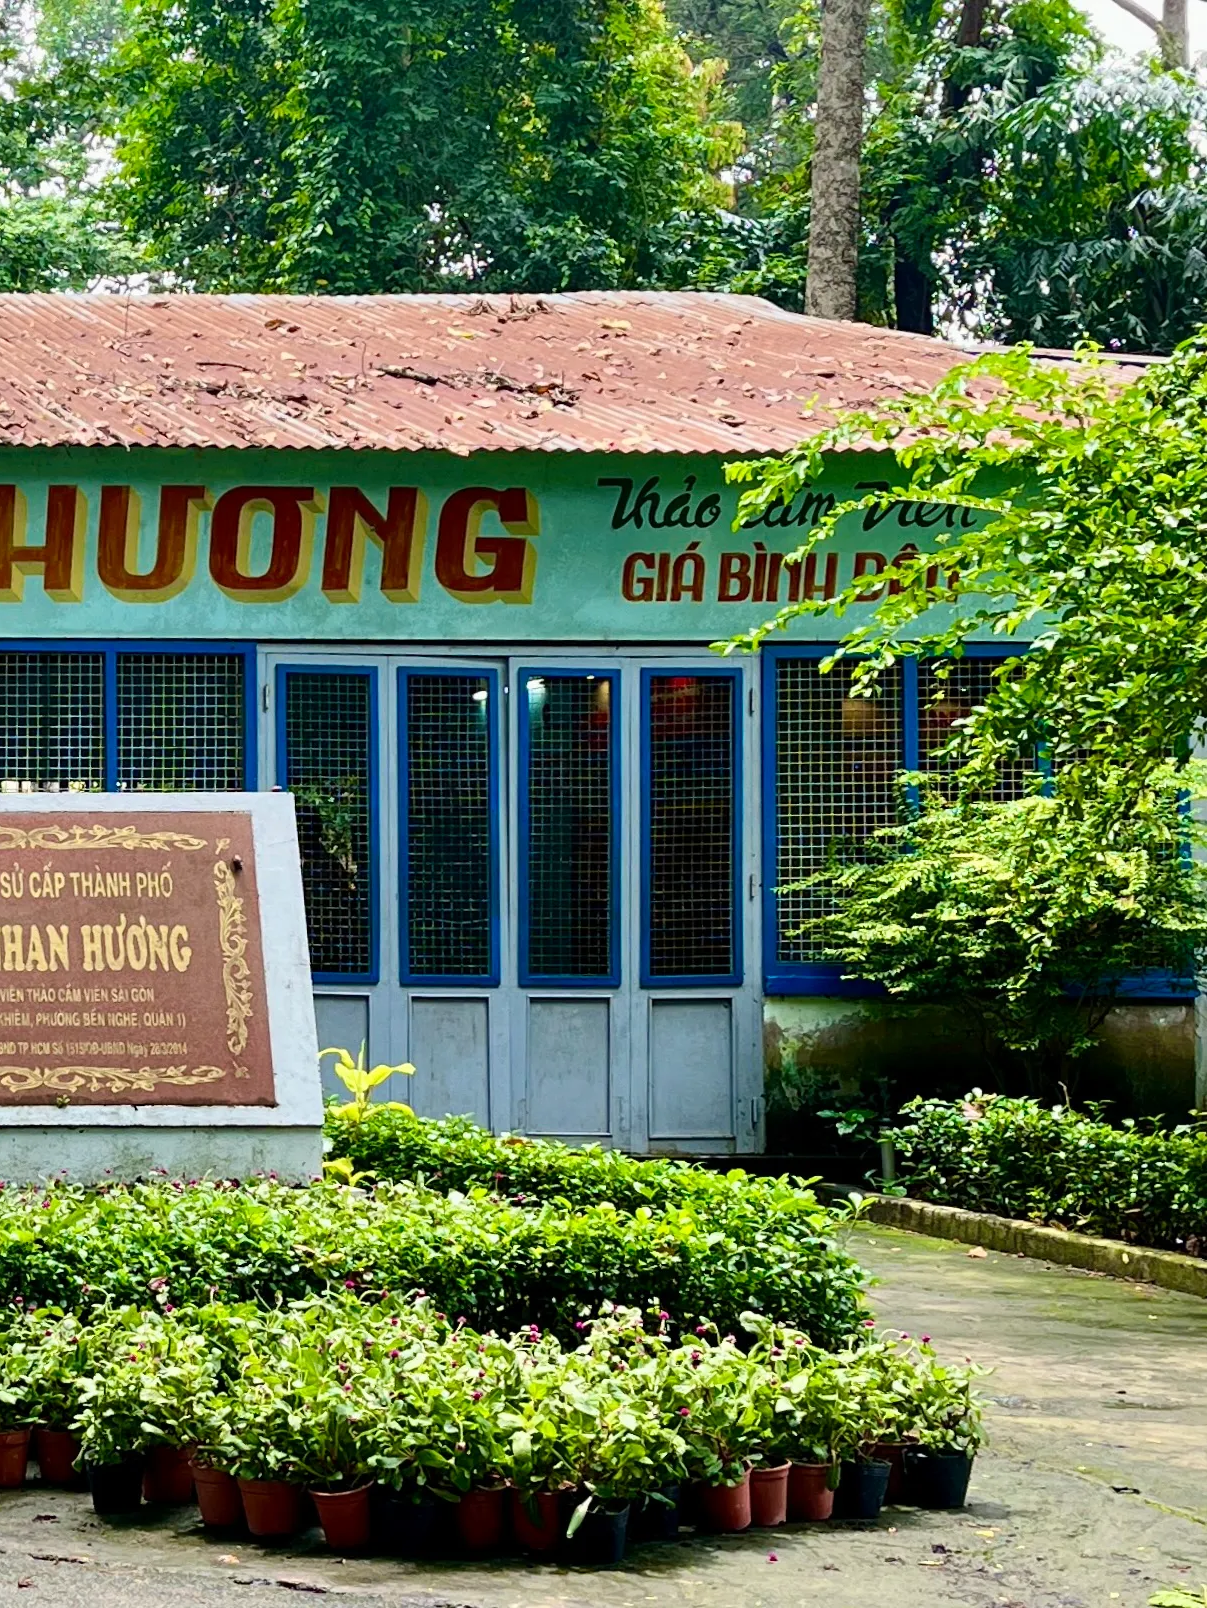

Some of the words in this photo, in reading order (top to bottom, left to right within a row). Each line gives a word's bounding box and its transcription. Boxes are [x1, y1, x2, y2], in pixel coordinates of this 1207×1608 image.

[597, 474, 722, 530] Thảo
[621, 540, 706, 602] GIÁ
[717, 541, 840, 603] BÌNH
[0, 862, 24, 898] SỬ
[28, 861, 66, 898] CẤP
[69, 864, 131, 898] THÀNH
[135, 861, 173, 898] PHỐ
[80, 913, 192, 972] HƯƠNG
